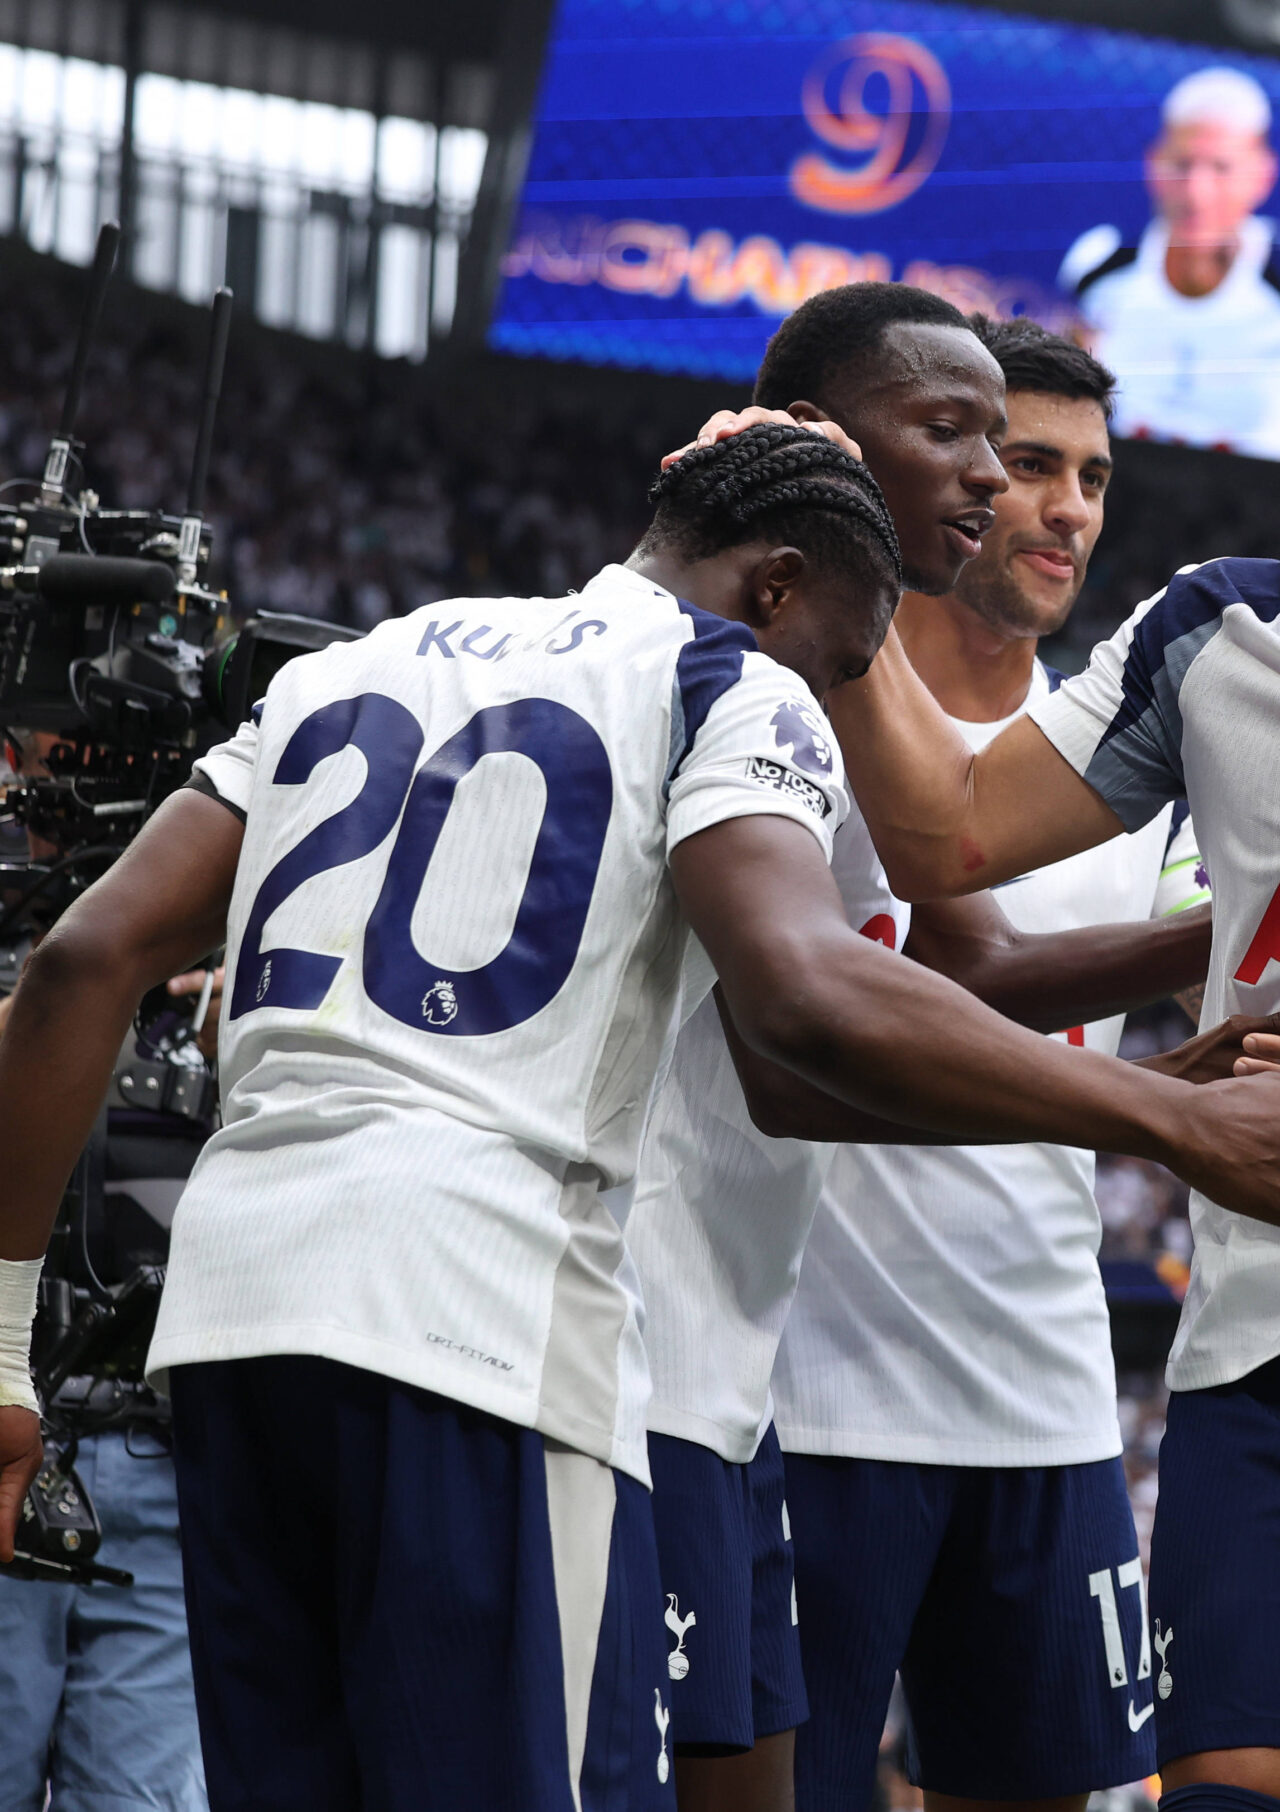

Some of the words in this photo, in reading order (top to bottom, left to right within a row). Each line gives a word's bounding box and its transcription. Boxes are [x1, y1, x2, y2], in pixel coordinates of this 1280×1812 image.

[789, 31, 951, 214] 9
[416, 610, 608, 663] KUS
[228, 692, 613, 1037] 20
[1088, 1556, 1152, 1688] 17
